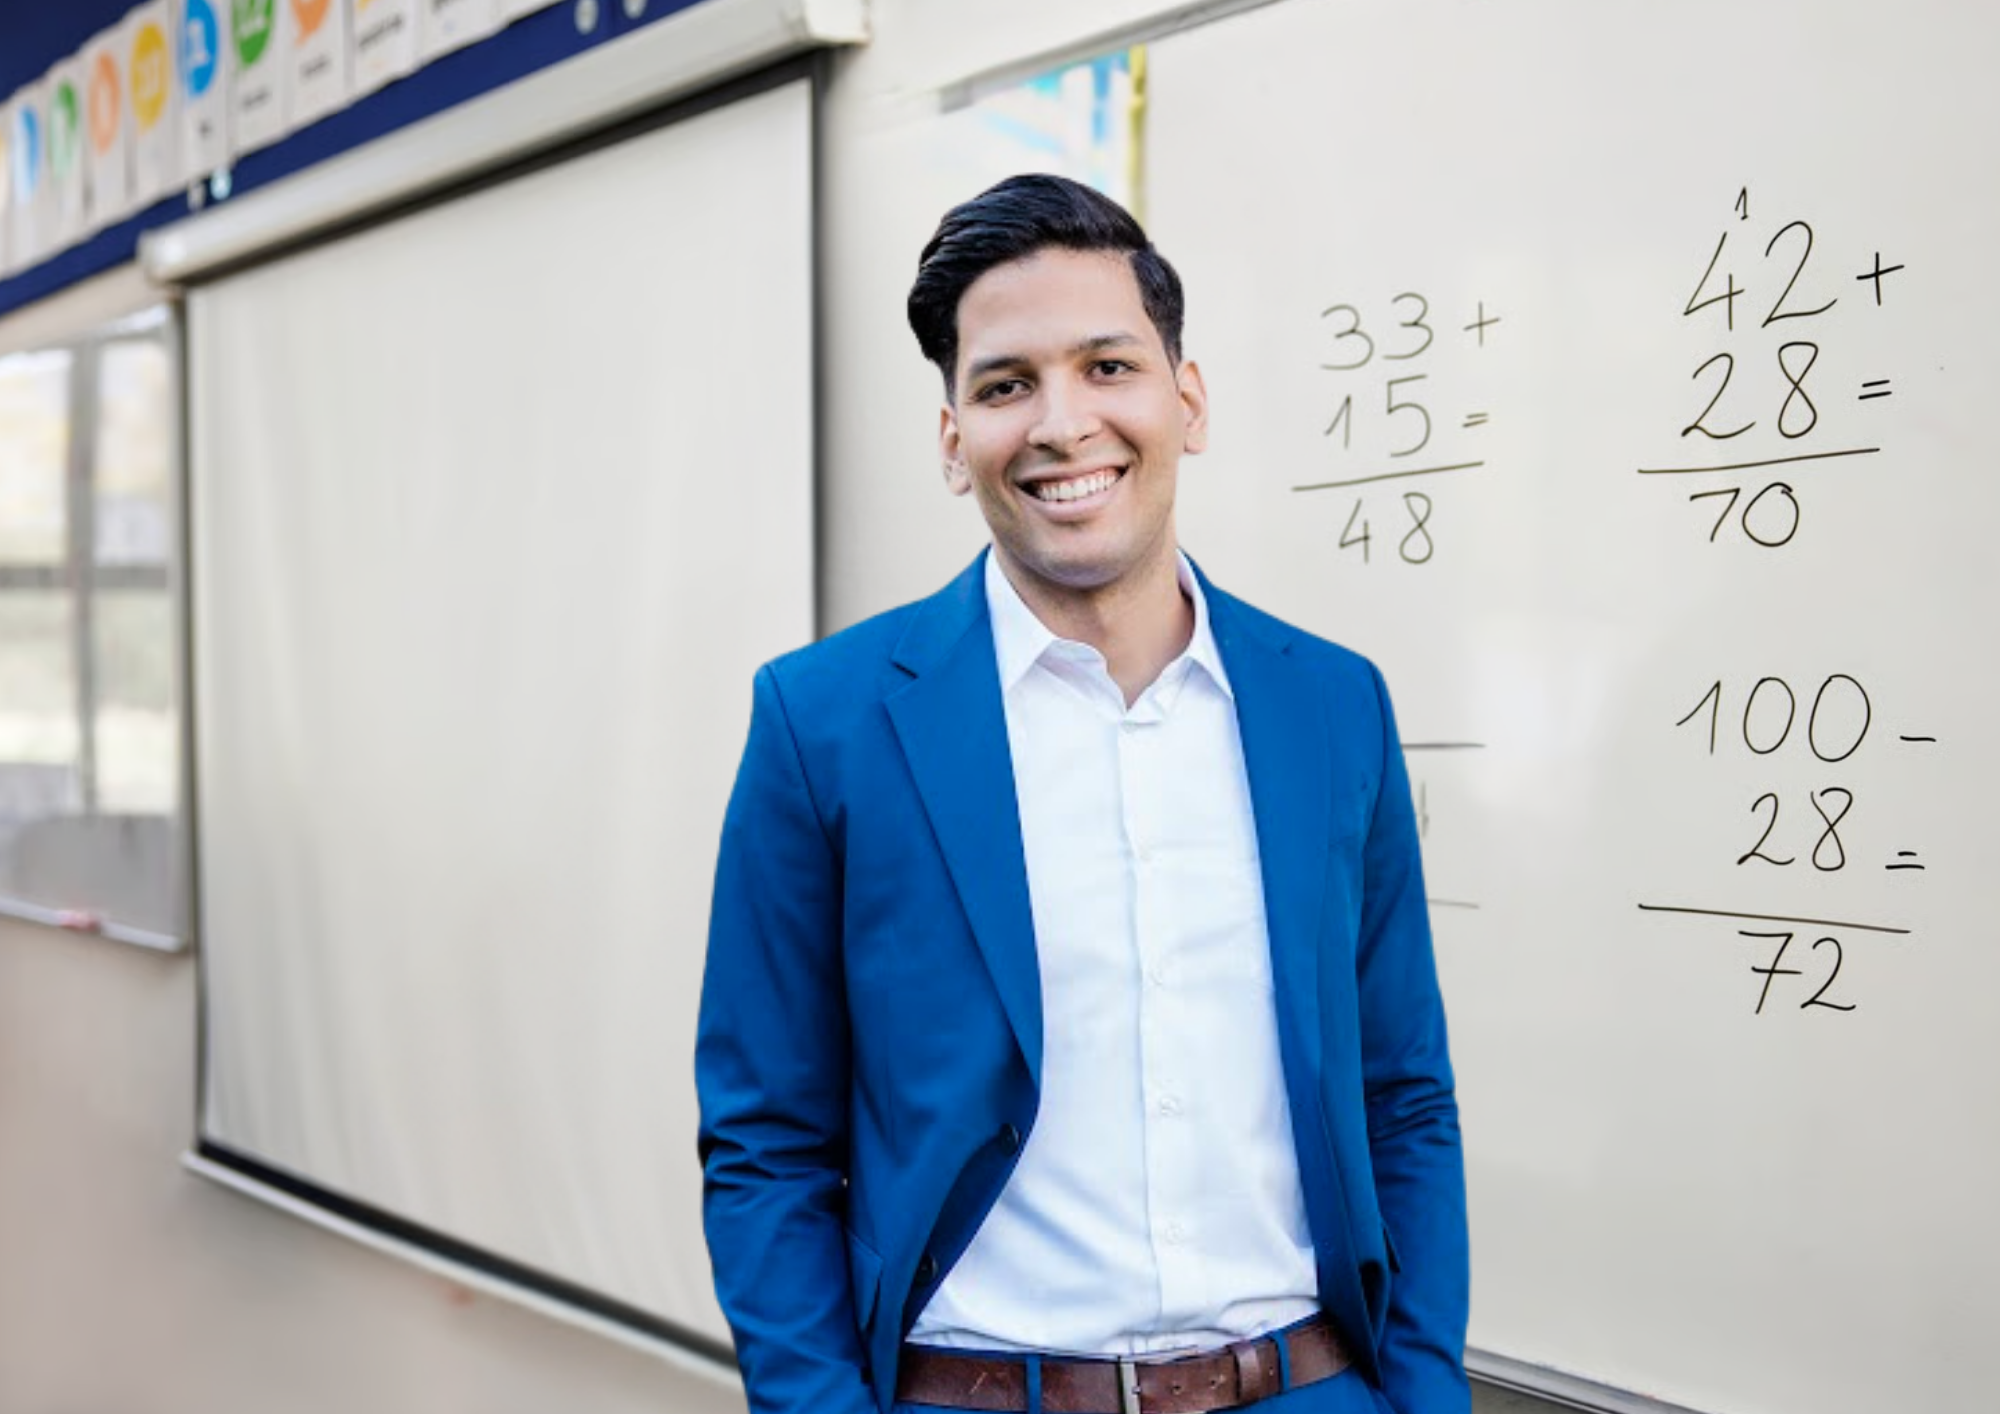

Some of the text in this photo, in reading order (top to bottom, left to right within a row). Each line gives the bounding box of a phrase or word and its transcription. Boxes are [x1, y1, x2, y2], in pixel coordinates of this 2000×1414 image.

[1734, 186, 1749, 220] 1
[1683, 220, 1906, 331] 42 +
[1320, 291, 1502, 371] 33 +
[1324, 374, 1489, 458] 15 =
[1681, 341, 1893, 440] 28 =
[1338, 492, 1435, 566] 48
[1689, 481, 1801, 548] 70
[1676, 674, 1872, 763] 100
[1736, 787, 1926, 872] 28 =
[1737, 930, 1857, 1015] 72
